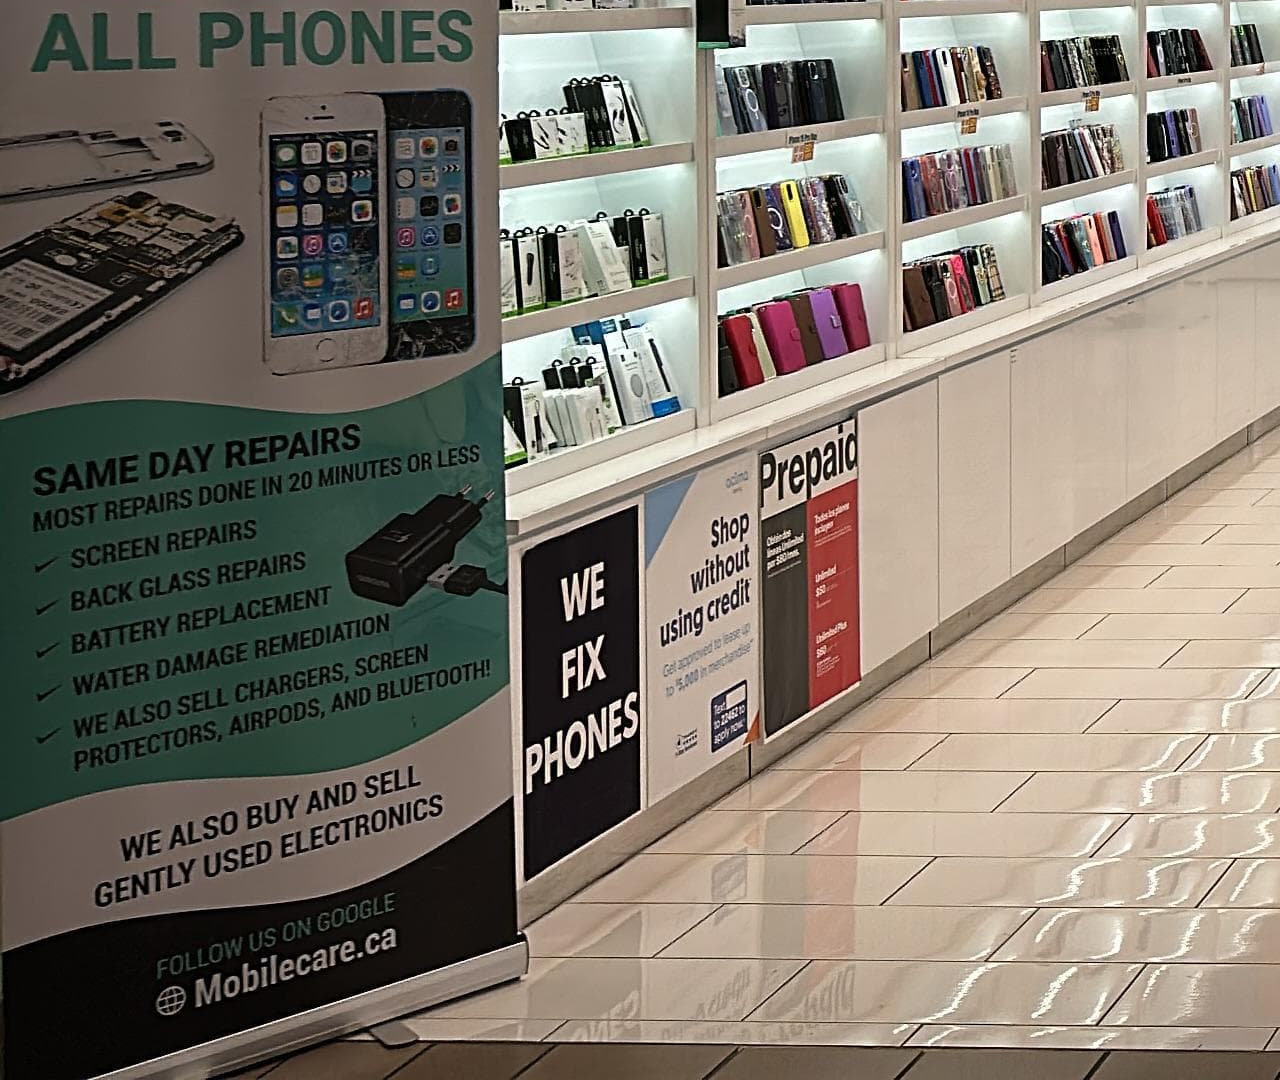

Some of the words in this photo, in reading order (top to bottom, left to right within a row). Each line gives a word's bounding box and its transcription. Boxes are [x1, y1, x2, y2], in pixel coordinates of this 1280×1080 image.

[30, 12, 177, 73] ALL
[198, 8, 475, 69] PHONES
[33, 452, 140, 497] SAME
[148, 443, 215, 481] DAY
[225, 423, 362, 469] REPAIRS
[33, 502, 98, 533] MOST
[105, 488, 194, 522] REPAIRS
[199, 479, 257, 508] DONE
[261, 474, 283, 497] IN
[288, 469, 313, 493] 20
[317, 457, 402, 490] MINUTES
[406, 449, 433, 473] OR
[437, 444, 481, 468] LESS
[760, 419, 858, 508] Prepaid
[70, 535, 161, 570] SCREEN
[166, 520, 258, 553] REPAIRS
[711, 512, 750, 548] Shop
[70, 580, 133, 612] BACK
[139, 566, 212, 601] GLASS
[217, 551, 307, 585] REPAIRS
[559, 560, 606, 623] WE
[690, 543, 750, 594] without
[70, 615, 172, 655] BATTERY
[177, 585, 332, 635] REPLACEMENT
[72, 662, 151, 696] WATER
[156, 642, 249, 680] DAMAGE
[254, 613, 391, 660] REMEDIATION
[660, 605, 704, 648] using
[72, 712, 109, 739] WE
[114, 700, 172, 732] ALSO
[177, 688, 229, 718] SELL
[234, 662, 351, 704] CHARGERS,
[354, 643, 430, 677] SCREEN
[560, 634, 608, 700] FIX
[72, 721, 223, 772] PROTECTORS,
[229, 698, 327, 738] AIRPODS,
[331, 684, 372, 715] AND
[376, 659, 492, 703] BLUETOOTH!
[525, 690, 640, 796] PHONES
[713, 727, 731, 745] apply
[120, 831, 162, 863] WE
[169, 812, 239, 851] ALSO
[246, 794, 300, 830] BUY
[306, 780, 357, 816] AND
[364, 765, 422, 802] SELL
[94, 858, 197, 909] GENTLY
[203, 838, 273, 878] USED
[279, 794, 444, 861] ELECTRONICS
[156, 935, 243, 980] FOLLOW
[248, 926, 277, 952] US
[281, 917, 312, 943] ON
[317, 891, 397, 933] GOOGLE
[193, 924, 399, 1008] Mobilecare.ca
